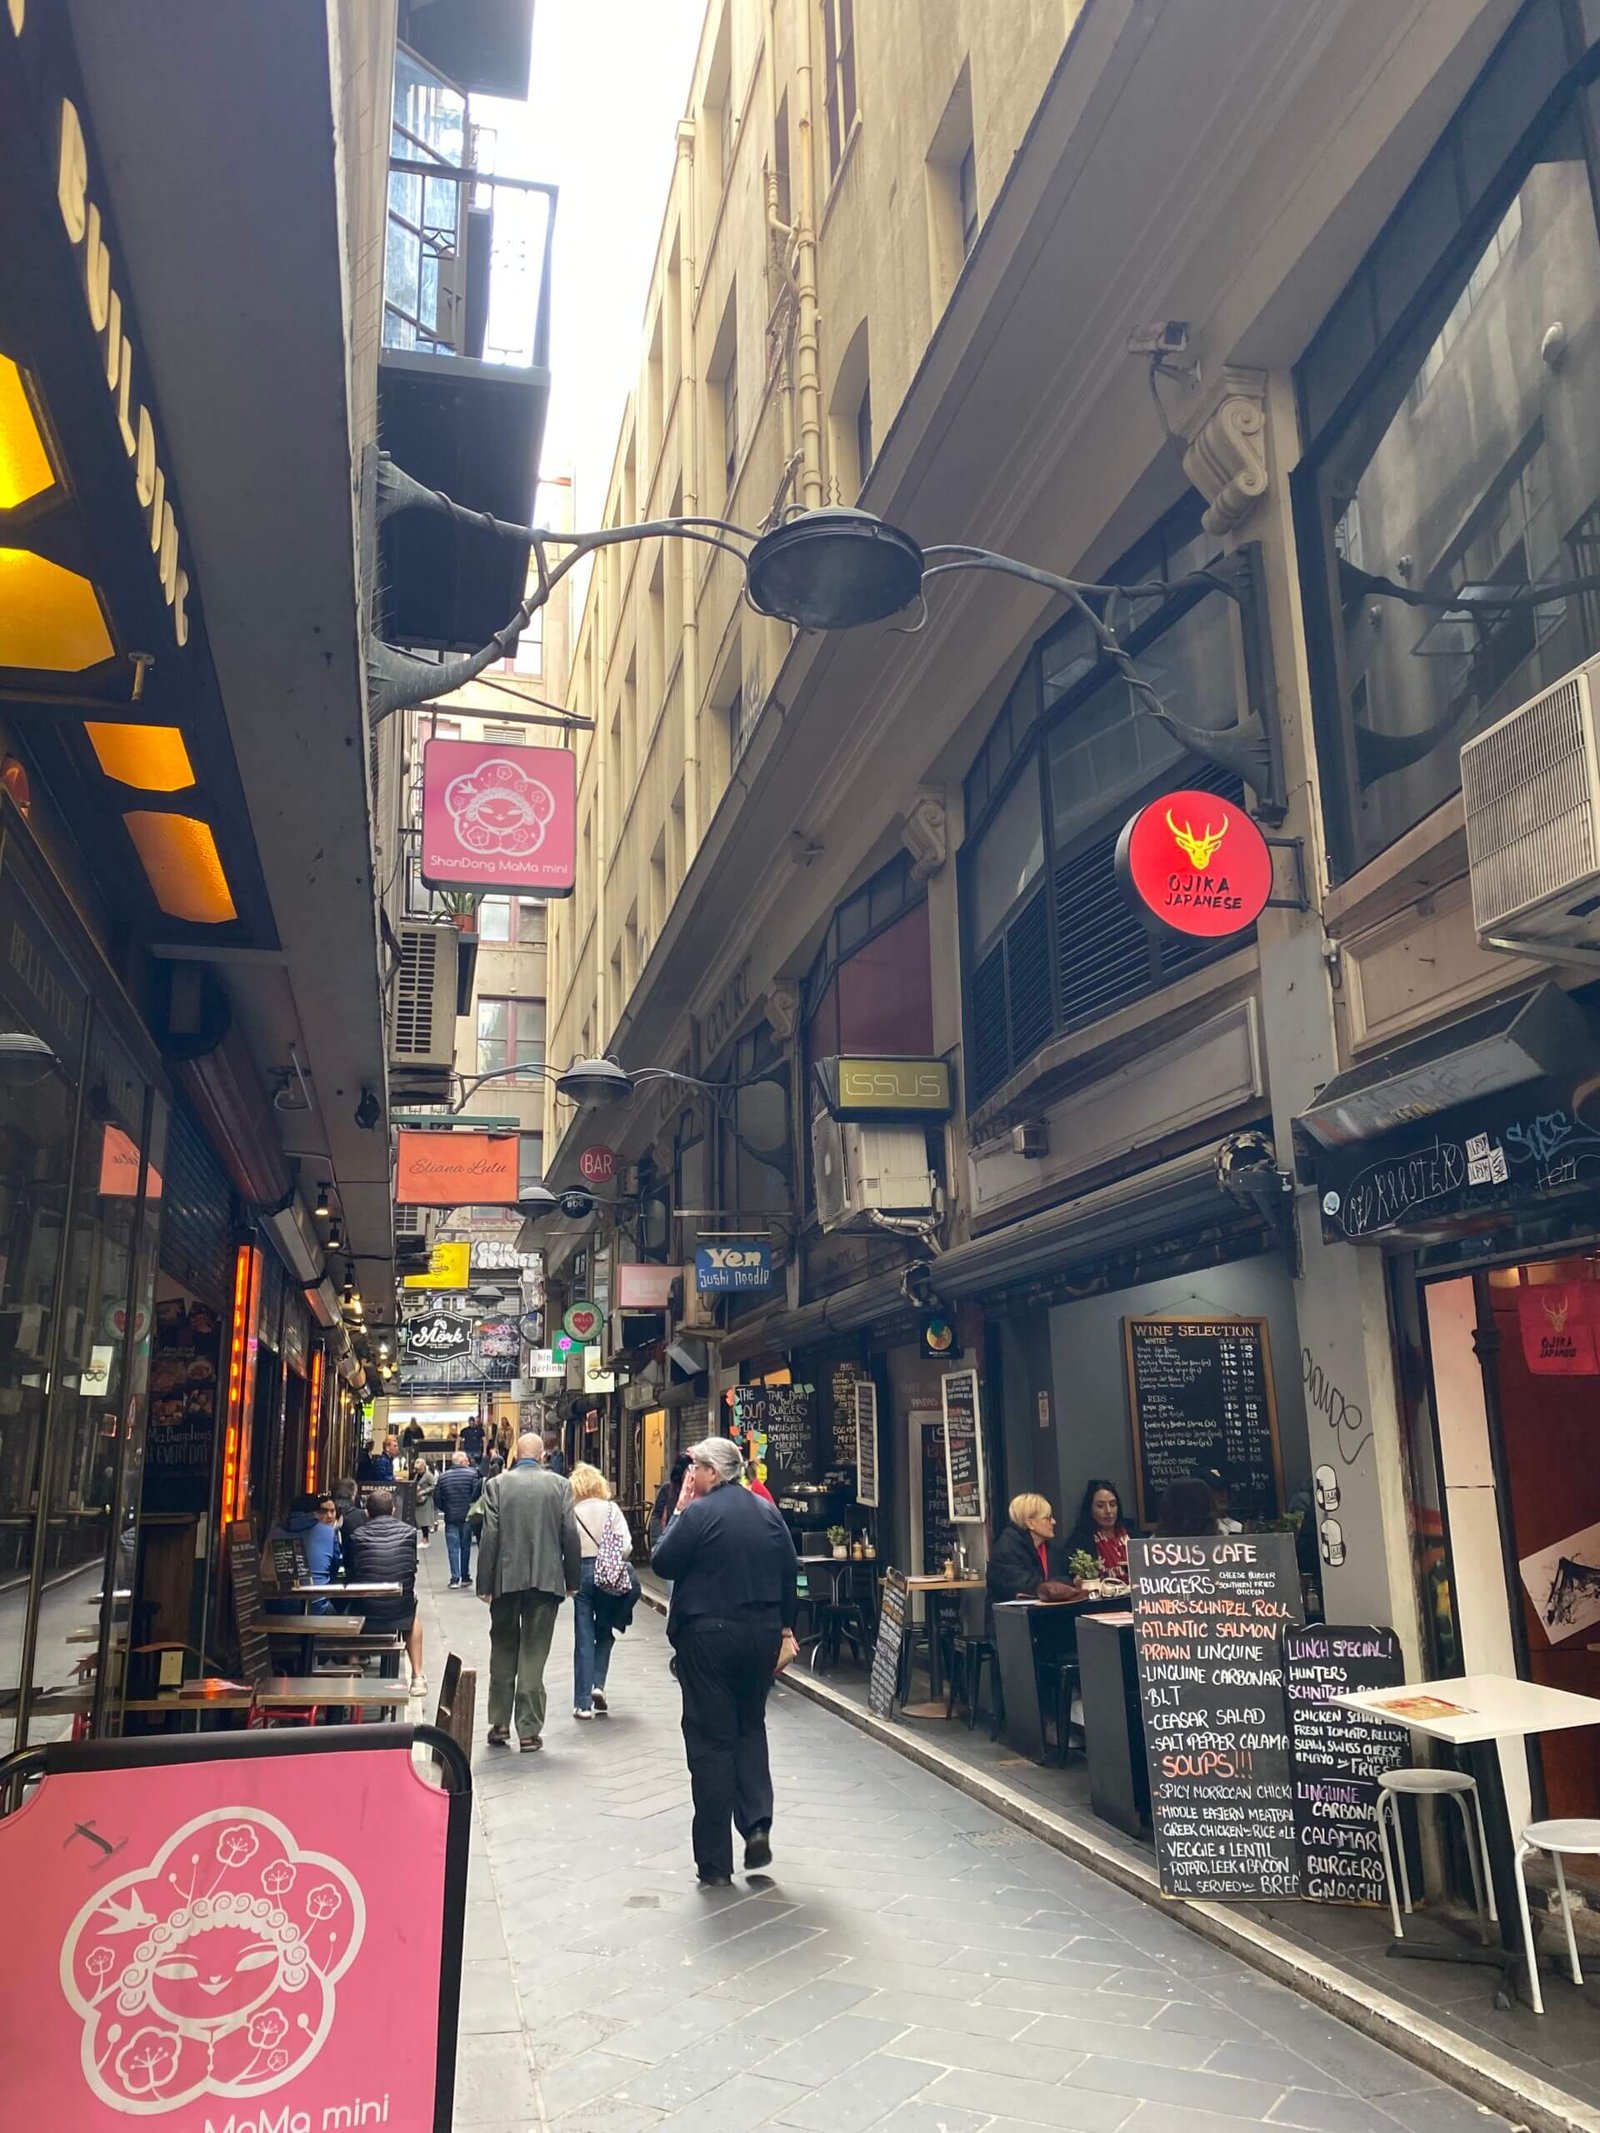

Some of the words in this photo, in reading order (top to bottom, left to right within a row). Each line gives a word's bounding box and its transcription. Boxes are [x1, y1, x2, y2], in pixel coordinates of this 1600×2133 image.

[430, 855, 496, 872] ShanDong
[499, 859, 539, 873] MaMa
[542, 863, 568, 874] mini
[1169, 874, 1230, 895] OJIKA
[1164, 893, 1243, 910] JAPANESE
[409, 1158, 465, 1176] Eliana
[467, 1158, 507, 1175] Lulu
[584, 1153, 613, 1174] BAR
[704, 1248, 762, 1268] Yen
[699, 1269, 729, 1288] Sushi
[1134, 1325, 1174, 1337] WINE
[1178, 1325, 1254, 1337] SELECTION
[737, 1388, 755, 1401] THE
[768, 1403, 808, 1416] BURGERS
[739, 1420, 764, 1432] PLACE
[1143, 1543, 1206, 1567] ISSUS
[1212, 1543, 1257, 1564] CAFE
[1139, 1576, 1215, 1595] BURGERS
[1138, 1600, 1187, 1615] HUNTERS
[1189, 1600, 1251, 1617] SCHNITZEL
[1252, 1599, 1296, 1618] ROLL
[1141, 1620, 1208, 1638] ATLANTIC
[1215, 1622, 1277, 1640] SALMON
[1143, 1644, 1191, 1661] PRAWN
[1197, 1643, 1263, 1662] LINGUINE
[1287, 1638, 1330, 1661] LUNCH
[1145, 1664, 1207, 1687] LINGUINE
[1289, 1666, 1348, 1683] HUNTERS
[1149, 1685, 1182, 1707] BLT
[1153, 1709, 1209, 1730] CEASAR
[1216, 1708, 1266, 1725] SALAD
[1293, 1709, 1342, 1723] CHICKEN
[1294, 1725, 1323, 1736] FRESH
[1154, 1733, 1185, 1751] SALT
[1190, 1732, 1236, 1751] PEPPER
[1327, 1740, 1361, 1754] SWISS
[1162, 1751, 1253, 1779] SOUPS!!!
[1159, 1783, 1190, 1799] SPICY
[1193, 1785, 1252, 1800] MORROCAN
[1297, 1782, 1361, 1805] LINGUINE
[1161, 1806, 1199, 1820] MIDDLE
[1203, 1806, 1244, 1821] EASTERN
[1312, 1802, 1395, 1826] CARBONAA
[1163, 1824, 1199, 1837] GREEK
[1199, 1824, 1244, 1838] CHICKEN
[1252, 1824, 1277, 1838] RICE
[1167, 1842, 1217, 1858] VEGGIE
[1230, 1842, 1279, 1859] LENTIL
[1211, 1860, 1237, 1874] LEEK
[1246, 1857, 1290, 1874] BACON
[1307, 1855, 1385, 1882] BURGERS
[1174, 1880, 1192, 1893] ALL
[1196, 1880, 1241, 1894] SERVED
[1308, 1879, 1383, 1901] GNOCCHI
[322, 2093, 390, 2131] mini
